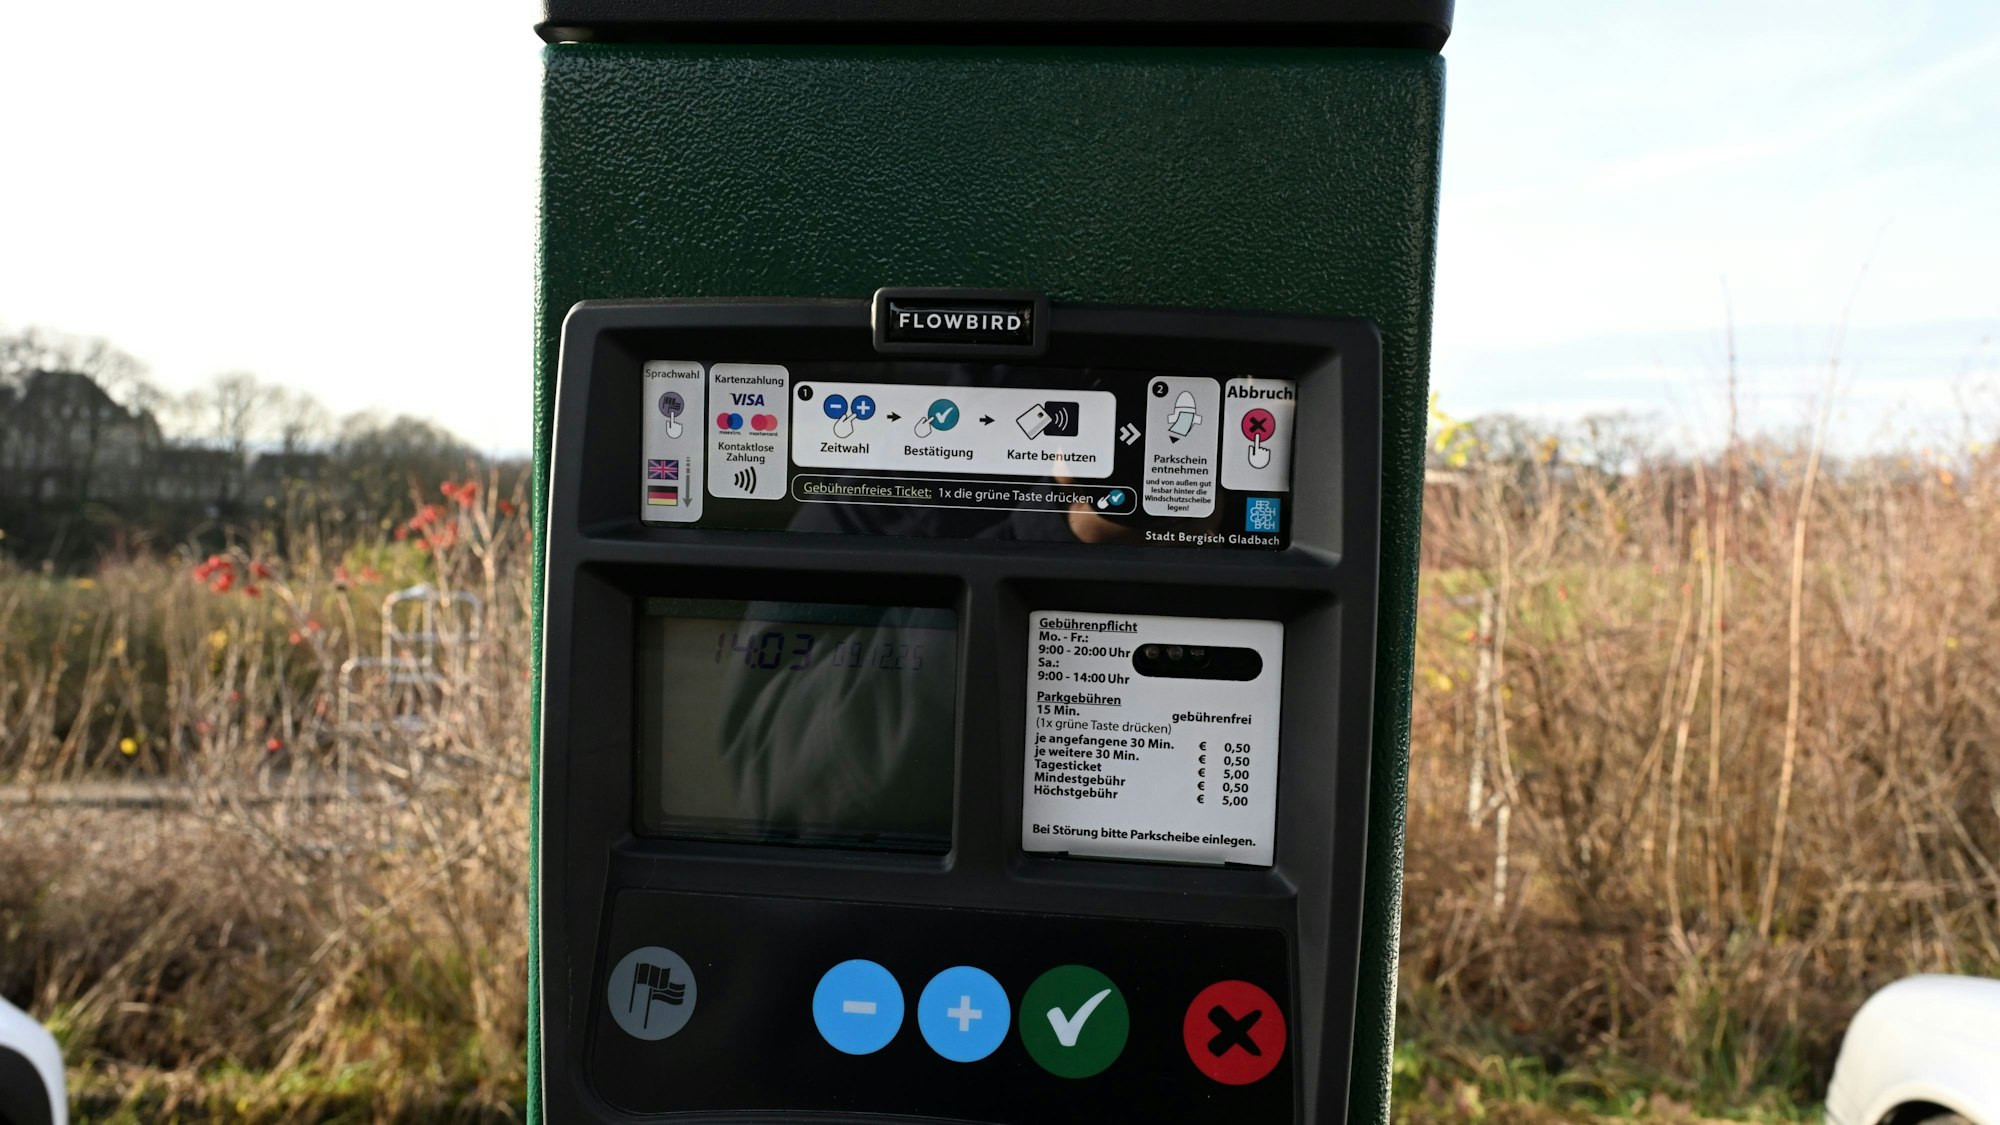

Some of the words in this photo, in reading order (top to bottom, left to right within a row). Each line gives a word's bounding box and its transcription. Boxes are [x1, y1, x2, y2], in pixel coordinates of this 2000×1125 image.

[899, 313, 1021, 330] FLOWBIRD
[645, 368, 700, 379] Sprachwahl
[715, 374, 784, 387] Kartenzahlung
[1227, 385, 1293, 399] Abbruch
[730, 393, 765, 406] VISA
[718, 442, 774, 453] Kontaktlose
[820, 442, 869, 454] Zeitwahl
[904, 445, 973, 460] Bestätigung
[726, 453, 765, 464] Zahlung
[1007, 449, 1038, 460] Karte
[1041, 450, 1096, 463] benutzen
[1153, 454, 1207, 465] Parkschein
[1151, 465, 1209, 475] entnehmen
[1175, 479, 1198, 487] außen
[1199, 481, 1212, 489] gut
[803, 481, 893, 497] Gebührenfreies
[895, 484, 932, 498] Ticket:
[939, 487, 951, 498] 1x
[954, 488, 972, 499] die
[975, 489, 1011, 502] grüne
[1012, 490, 1042, 501] Taste
[1048, 491, 1093, 503] drücken
[1144, 494, 1212, 504] Windschutzscheibe
[1167, 504, 1189, 512] legen!
[1145, 530, 1175, 541] Stadt
[1178, 532, 1225, 545] Bergisch
[1228, 534, 1280, 546] Gladbach
[1039, 617, 1138, 632] Gebührenpflicht
[1038, 631, 1061, 642] Mo.
[1070, 632, 1089, 643] Fr.:
[1038, 644, 1064, 655] 9:00
[1073, 646, 1107, 657] 20:00
[1108, 647, 1131, 658] Uhr
[1038, 658, 1059, 668] Sa.:
[1037, 671, 1064, 681] 9:00
[1073, 672, 1106, 683] 14:00
[1108, 673, 1130, 684] Uhr
[1036, 691, 1121, 706] Parkgebühren
[1037, 704, 1050, 714] 15
[1053, 705, 1080, 716] Min.
[1172, 712, 1252, 725] gebührenfrei
[1036, 717, 1052, 729] (1x
[1055, 718, 1088, 731] grüne
[1090, 720, 1119, 731] Taste
[1122, 721, 1172, 735] drücken)
[1034, 733, 1046, 745] je
[1048, 734, 1128, 748] angefangene
[1130, 738, 1145, 748] 30
[1147, 738, 1174, 749] Min.
[1199, 741, 1207, 751] €
[1224, 742, 1250, 753] 0,50
[1034, 746, 1046, 758] je
[1048, 747, 1093, 758] weitere
[1095, 749, 1110, 759] 30
[1113, 750, 1139, 761] Min.
[1199, 754, 1206, 764] €
[1223, 756, 1250, 767] 0,50
[1034, 759, 1102, 772] Tagesticket
[1198, 768, 1205, 777] €
[1223, 769, 1249, 780] 5,00
[1034, 772, 1126, 787] Mindestgebühr
[1197, 781, 1205, 791] €
[1222, 782, 1249, 793] 0,50
[1033, 785, 1118, 800] Höchstgebühr
[1196, 794, 1204, 804] €
[1222, 795, 1248, 807] 5,00
[1032, 823, 1050, 834] Bei
[1052, 824, 1098, 839] Störung
[1100, 828, 1128, 839] bitte
[1130, 829, 1200, 843] Parkscheibe
[1202, 834, 1256, 847] einlegen.
